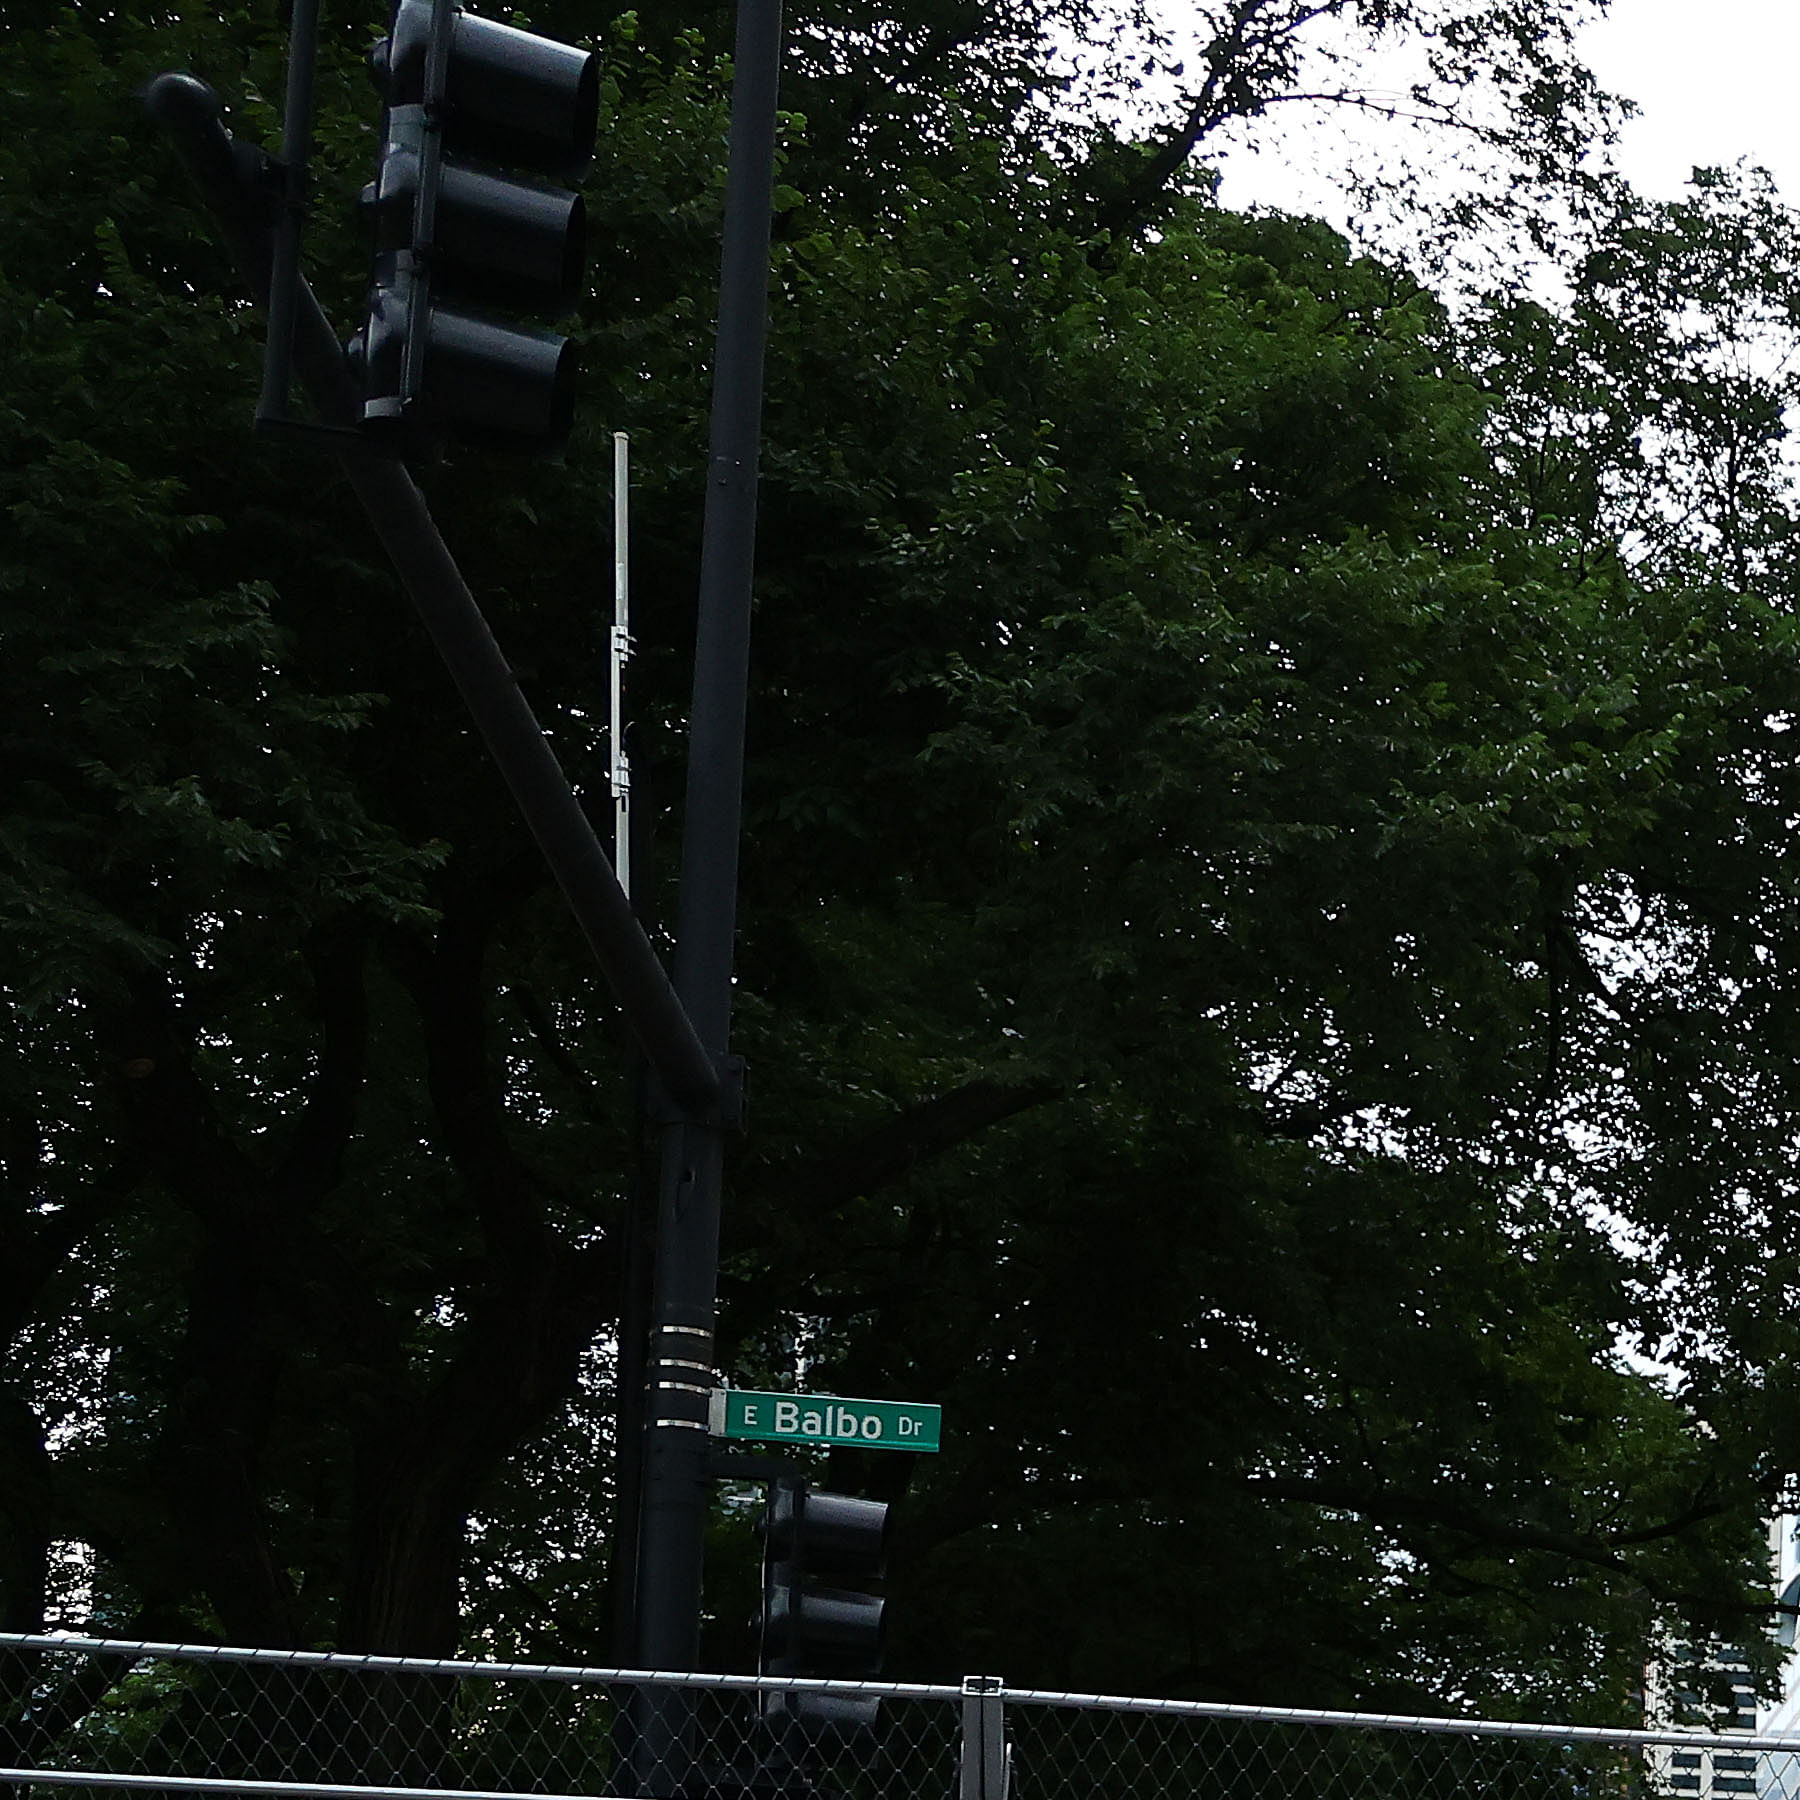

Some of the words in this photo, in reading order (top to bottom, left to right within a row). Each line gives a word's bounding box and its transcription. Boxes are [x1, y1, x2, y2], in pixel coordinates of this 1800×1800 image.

[744, 1405, 758, 1425] E
[775, 1401, 883, 1440] Balbo
[898, 1416, 923, 1437] Dr
